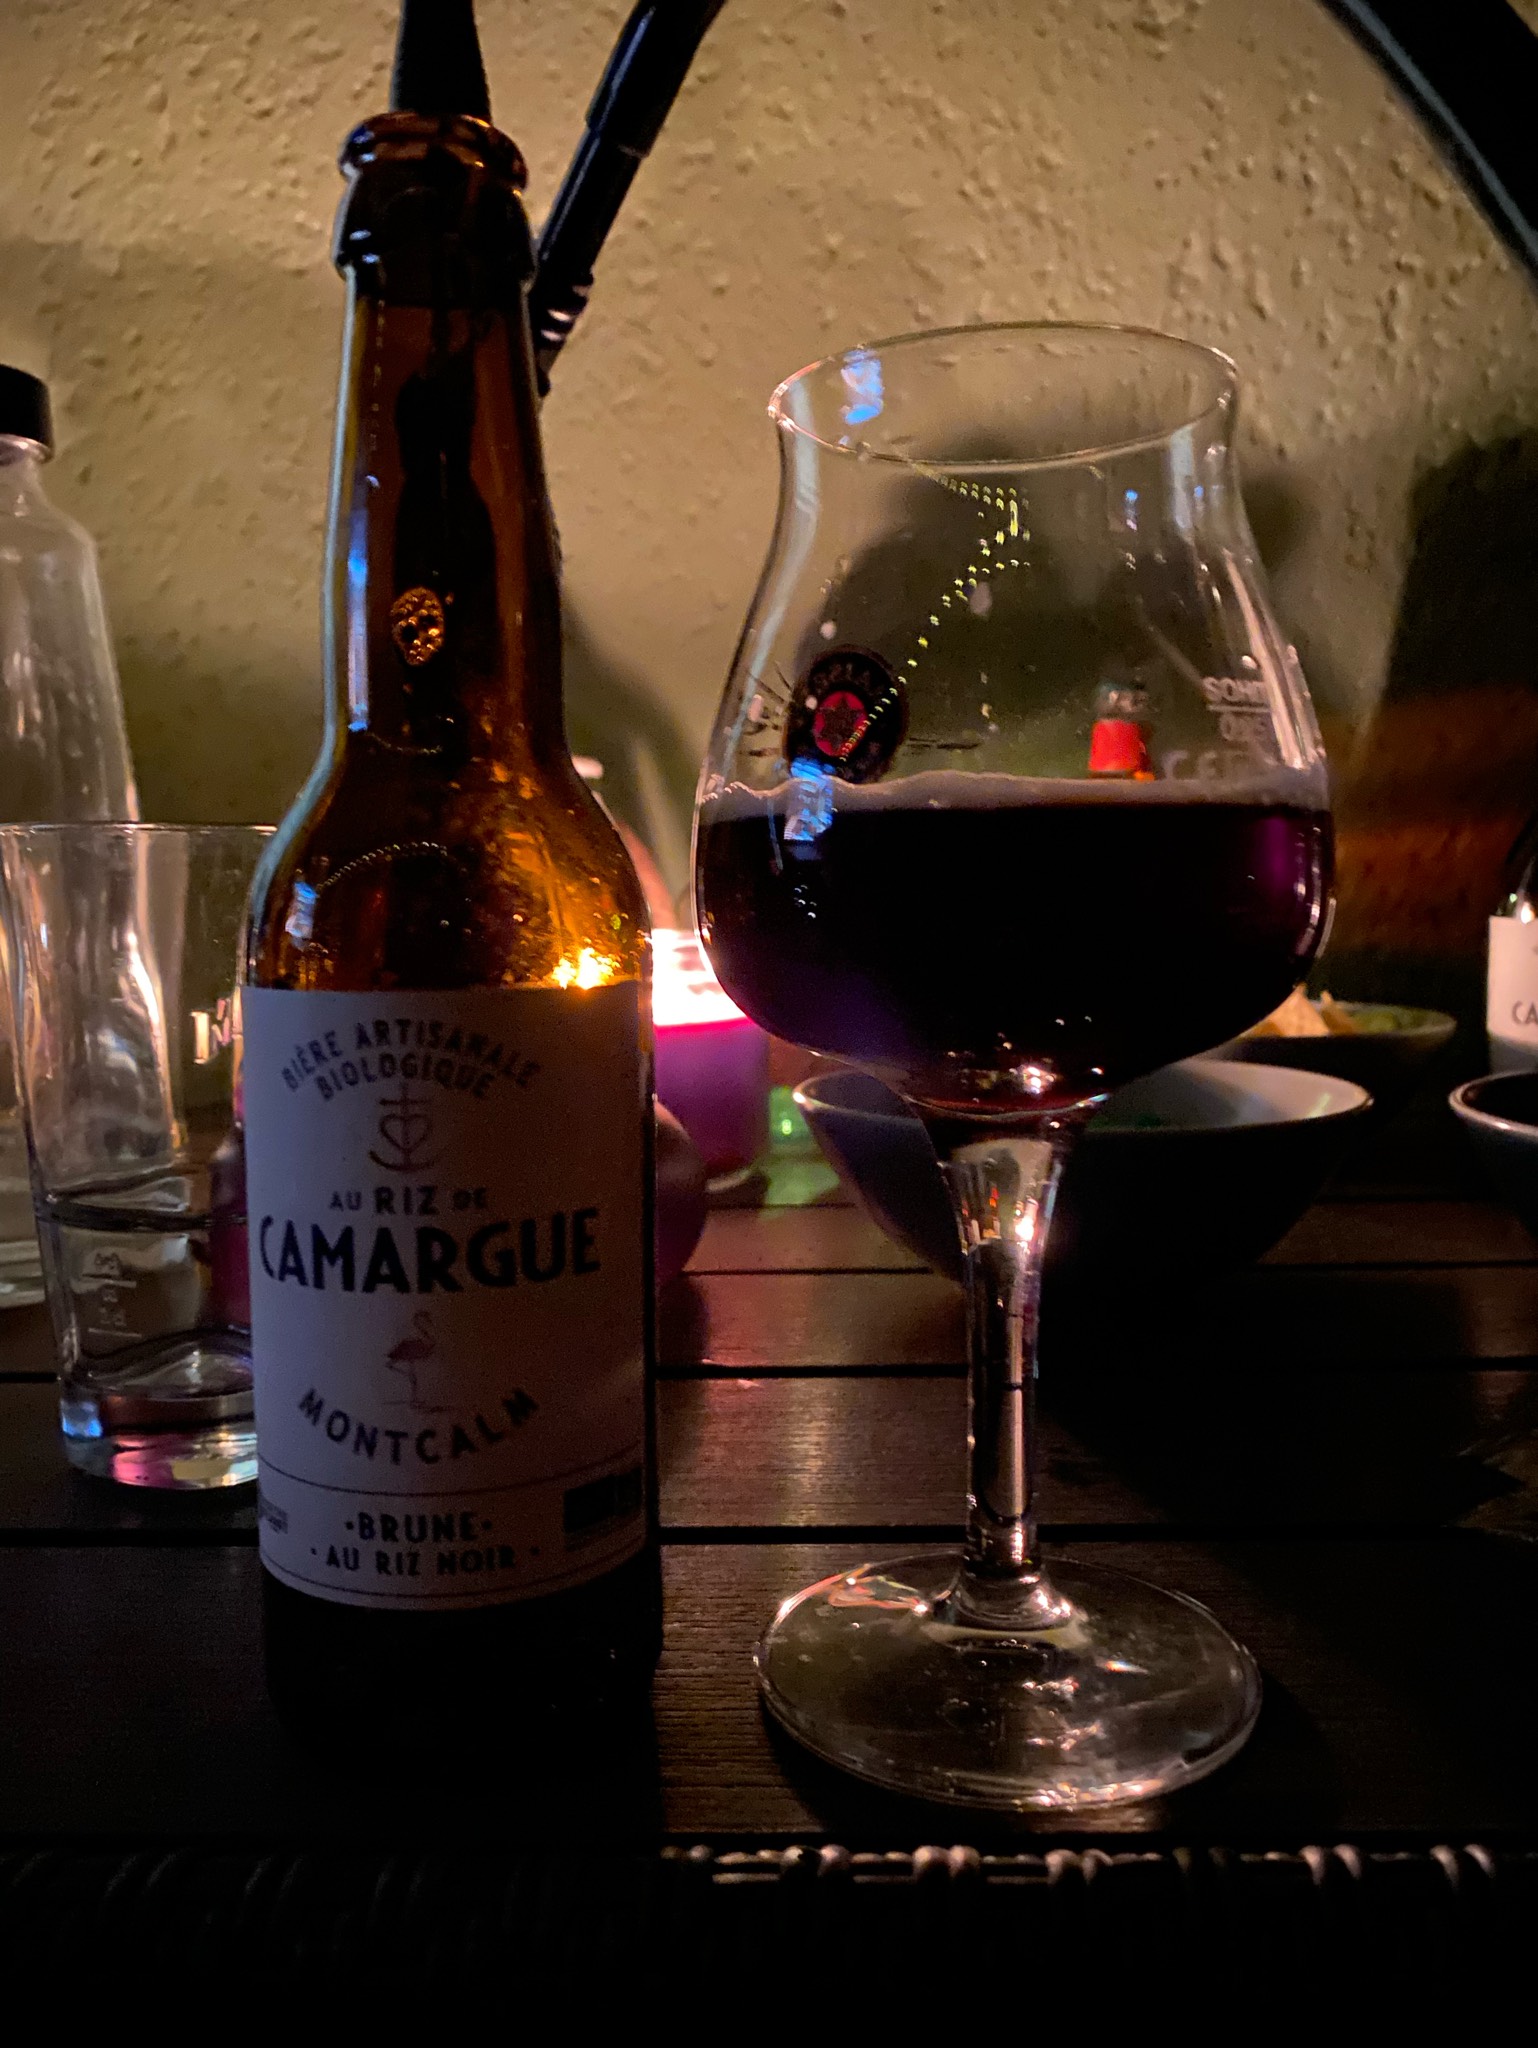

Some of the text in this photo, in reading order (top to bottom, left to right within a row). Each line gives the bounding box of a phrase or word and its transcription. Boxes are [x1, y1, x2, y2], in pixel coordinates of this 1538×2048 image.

[316, 1052, 495, 1101] BIOLOGIQUE
[355, 1018, 541, 1089] ARTISANALE
[330, 1186, 488, 1215] AU RIZ DE
[260, 1207, 602, 1294] CAMARGUE
[299, 1387, 538, 1465] MONTCALM
[357, 1511, 478, 1544] BRUNE
[326, 1545, 516, 1577] AU RIZ NOIR
